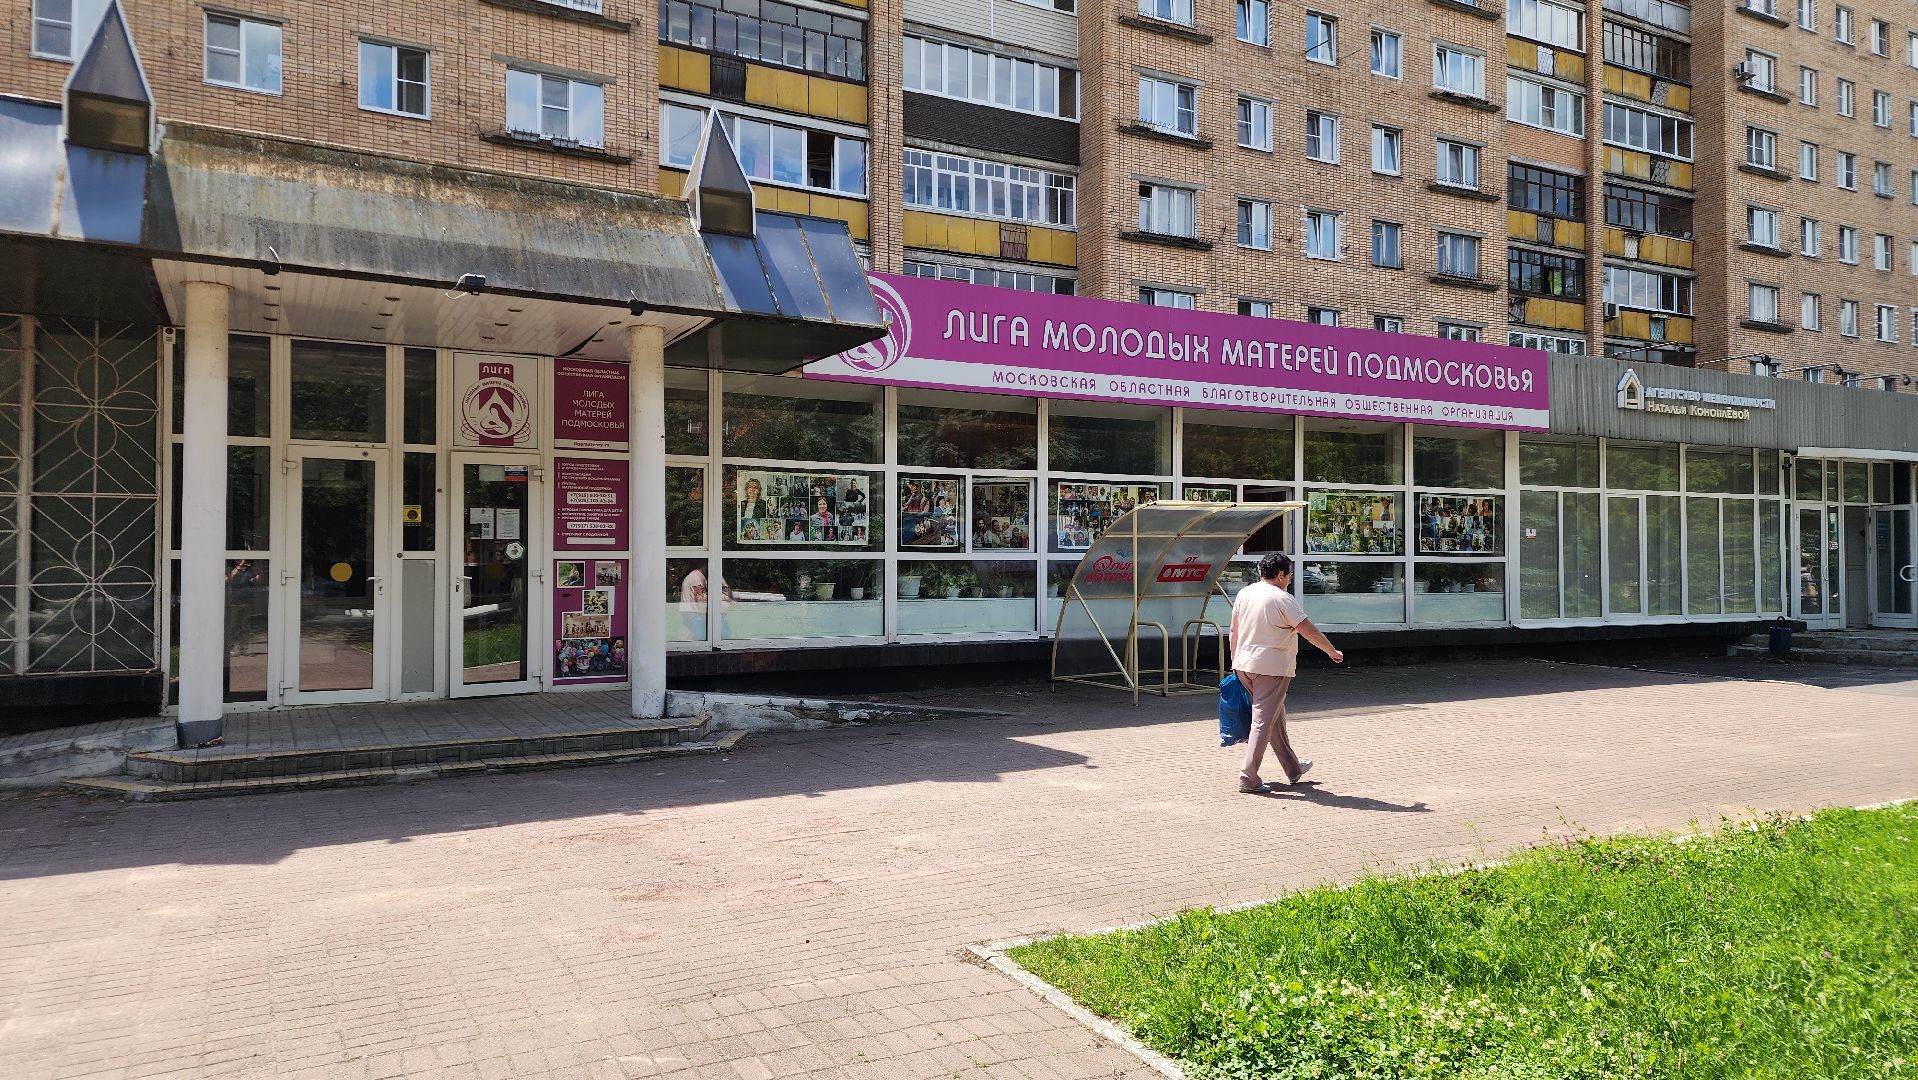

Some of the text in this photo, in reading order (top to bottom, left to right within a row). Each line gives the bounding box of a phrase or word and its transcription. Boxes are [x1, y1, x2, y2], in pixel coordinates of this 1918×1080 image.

[943, 308, 1534, 393] ЛИГА МОЛОДЫХ МАТЕРЕЙ ПОДМОСКОВЬЯ
[482, 365, 511, 375] ЛИГА
[582, 390, 605, 399] ЛИГА
[992, 370, 1514, 422] МОСКОВСКАЯ ОБЛАСТНАЯ БЛАГОТВОРИТЕЛЬНАЯ ОБЩЕСТВЕННАЯ ОРГАНИЗАЦИЯ
[1645, 387, 1701, 401] АГЕНТСТВО
[572, 399, 615, 409] МОЛОДЫХ
[574, 409, 612, 419] МАТЕРЕЙ
[561, 419, 625, 429] ПОДМОСКОВЬЯ
